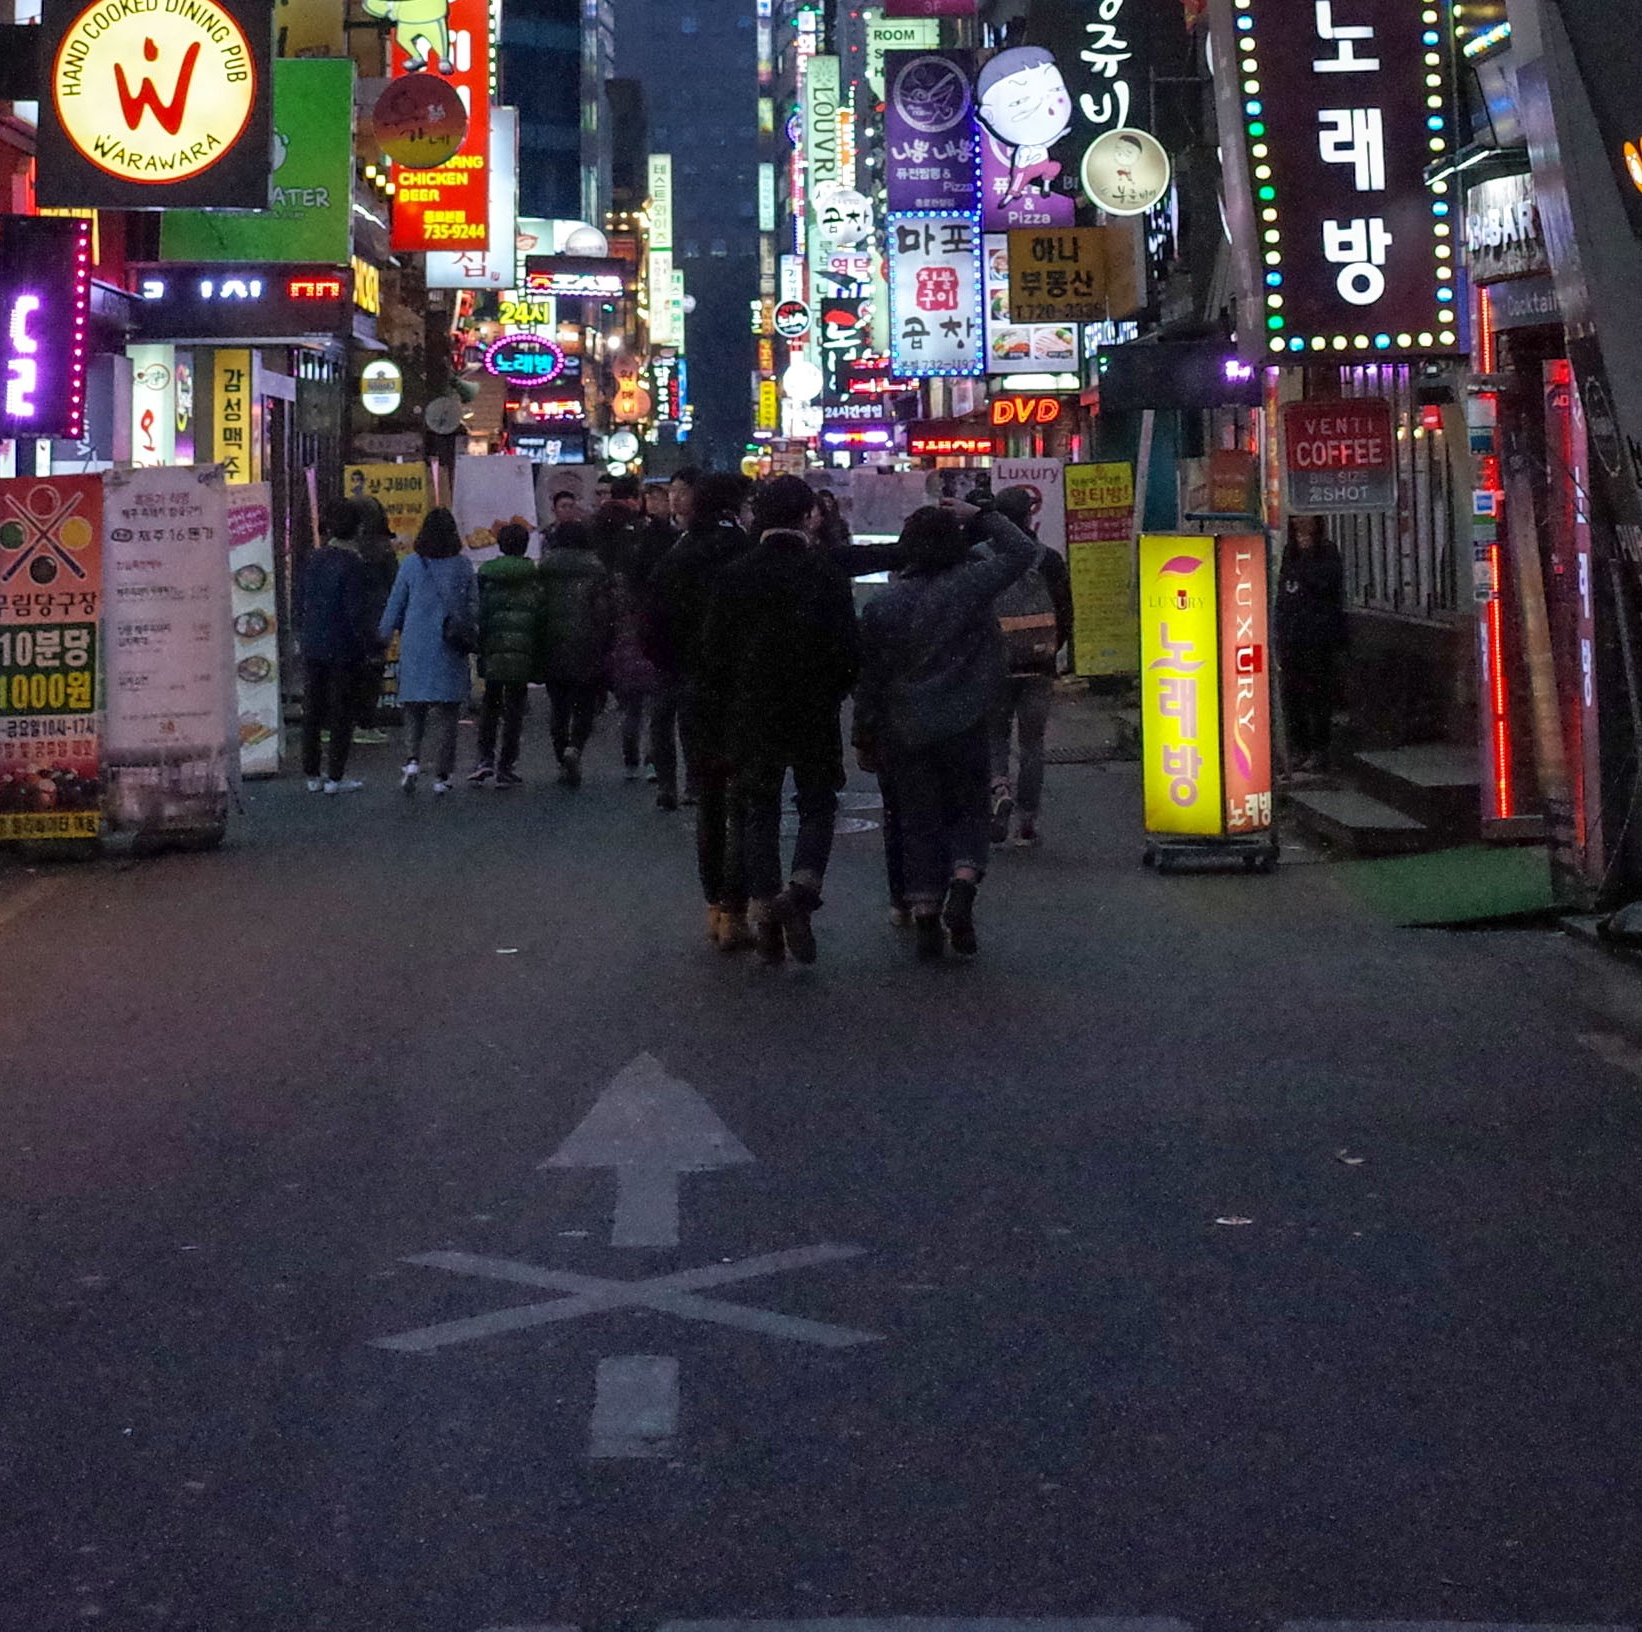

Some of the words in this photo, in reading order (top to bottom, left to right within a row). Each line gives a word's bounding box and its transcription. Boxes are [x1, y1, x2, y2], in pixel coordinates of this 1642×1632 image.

[873, 29, 915, 41] ROOM
[62, 39, 90, 97] HAND
[220, 44, 249, 83] PUB
[812, 86, 836, 182] LOUVR
[93, 133, 222, 172] WARAWARA
[398, 172, 469, 186] CHICKEN
[942, 181, 975, 193] Pizza
[271, 186, 331, 208] ATER
[398, 188, 441, 203] BEER
[1023, 197, 1035, 211] &
[1007, 211, 1052, 225] Pizza
[423, 224, 485, 240] 735-9244
[896, 224, 973, 256] 마포
[1030, 235, 1081, 264] 하나
[1020, 270, 1095, 299] 부동산
[918, 289, 956, 309] 구이
[499, 301, 551, 326] 24시
[901, 315, 974, 350] 곱창
[495, 353, 554, 375] 노래방
[824, 404, 883, 418] 24시간영업
[992, 394, 1059, 425] DVD
[223, 367, 246, 481] 감성맥주
[1304, 416, 1374, 436] VENTI
[1296, 438, 1383, 467] COFFEE
[997, 465, 1059, 484] Luxury
[1308, 487, 1370, 503] 2SHOT
[1148, 589, 1205, 611] LUXURY
[1234, 552, 1263, 733] LUXURY
[1228, 791, 1273, 829] 노래방
